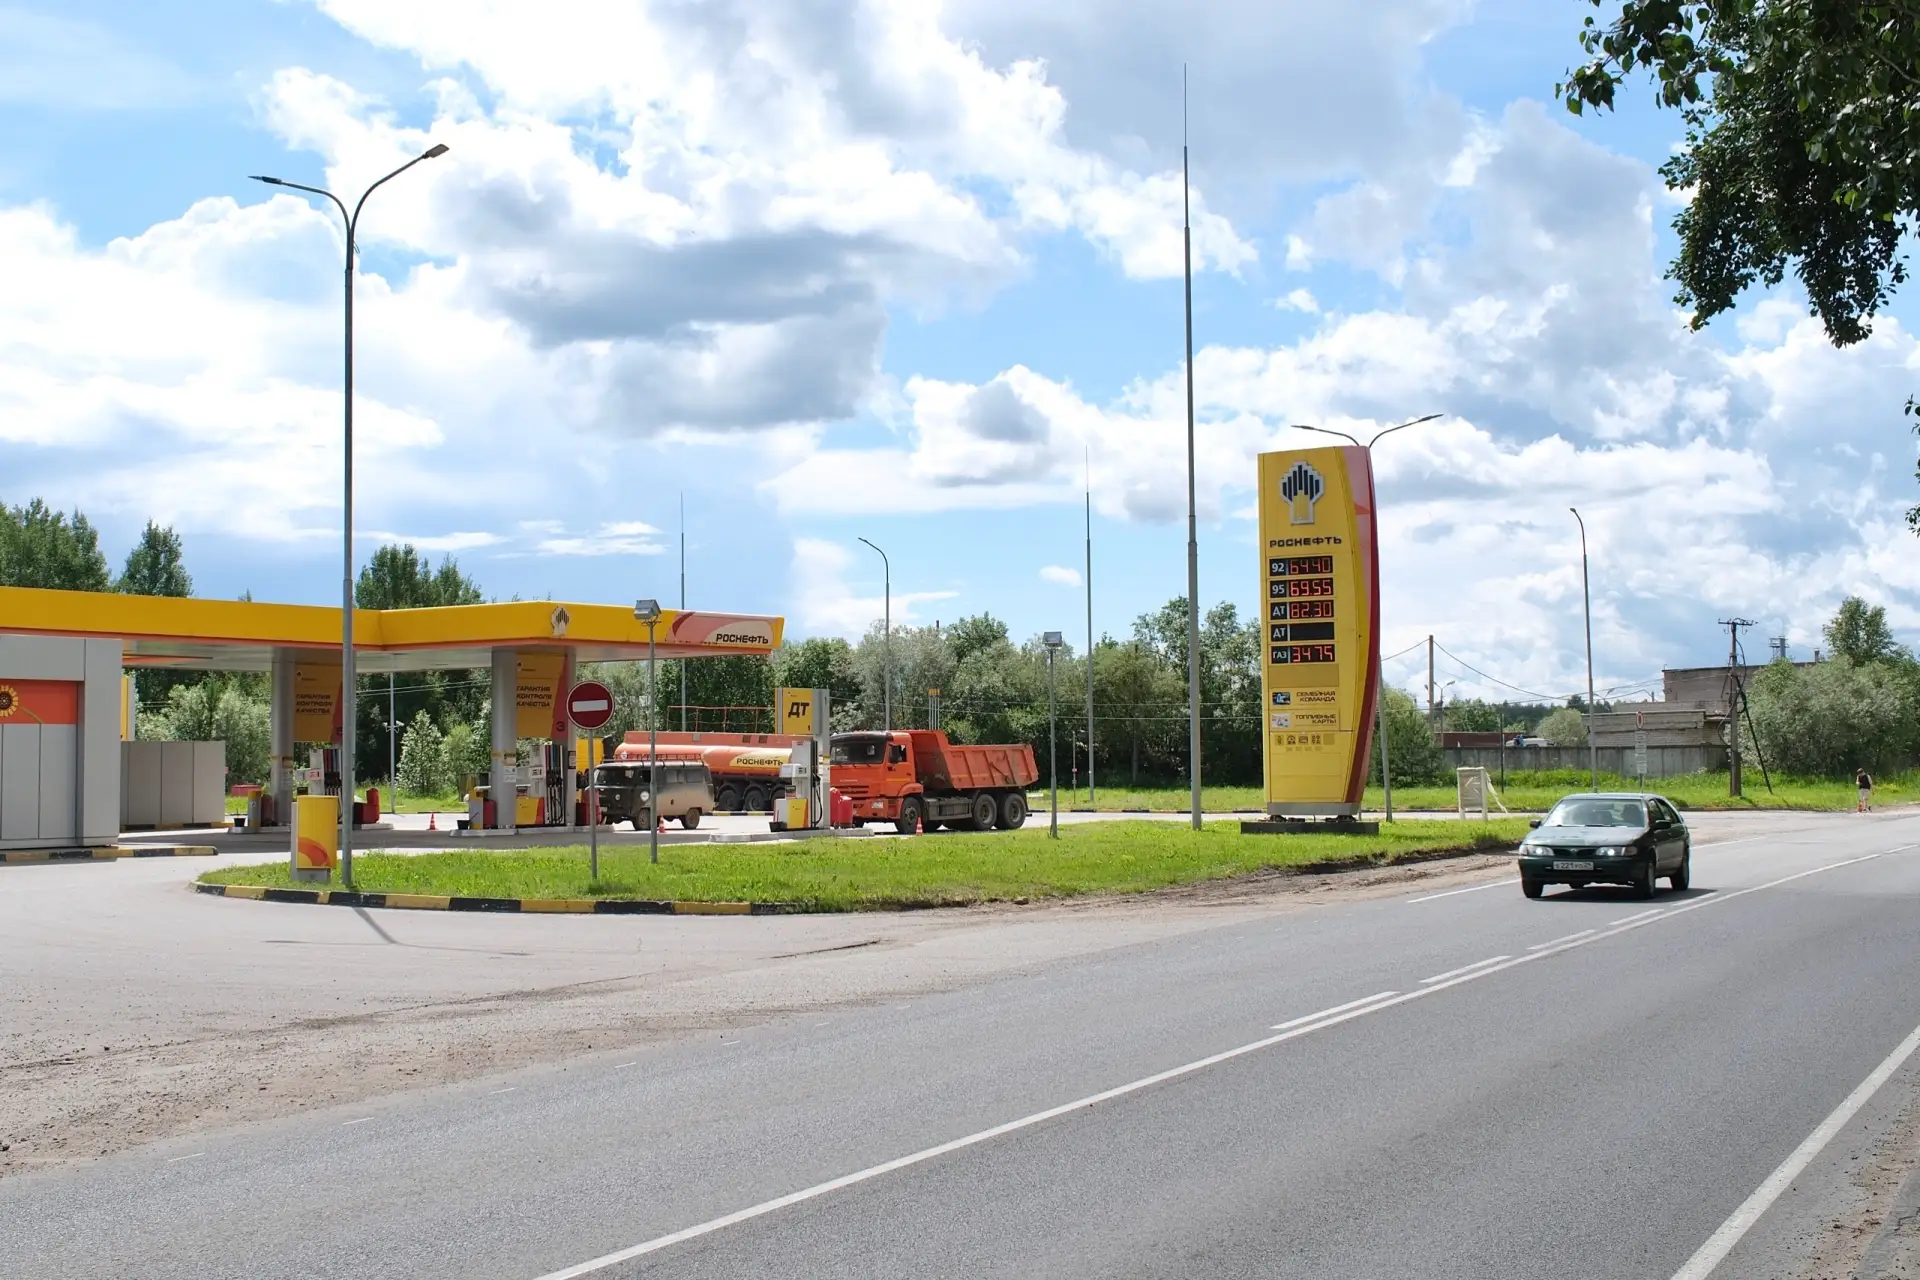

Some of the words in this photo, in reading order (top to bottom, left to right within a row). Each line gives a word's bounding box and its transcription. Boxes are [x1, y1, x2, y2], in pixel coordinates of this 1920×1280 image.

[1269, 536, 1342, 548] РОСНЕФТЬ
[1271, 562, 1285, 573] 92
[1272, 584, 1285, 595] 95
[1272, 605, 1286, 617] ДТ
[716, 633, 769, 644] РОСНЕФТЬ
[1272, 627, 1286, 639] ДТ
[1272, 651, 1287, 659] ГАЗ
[788, 702, 810, 718] ДТ
[736, 758, 783, 766] РОСНЕФТЬ
